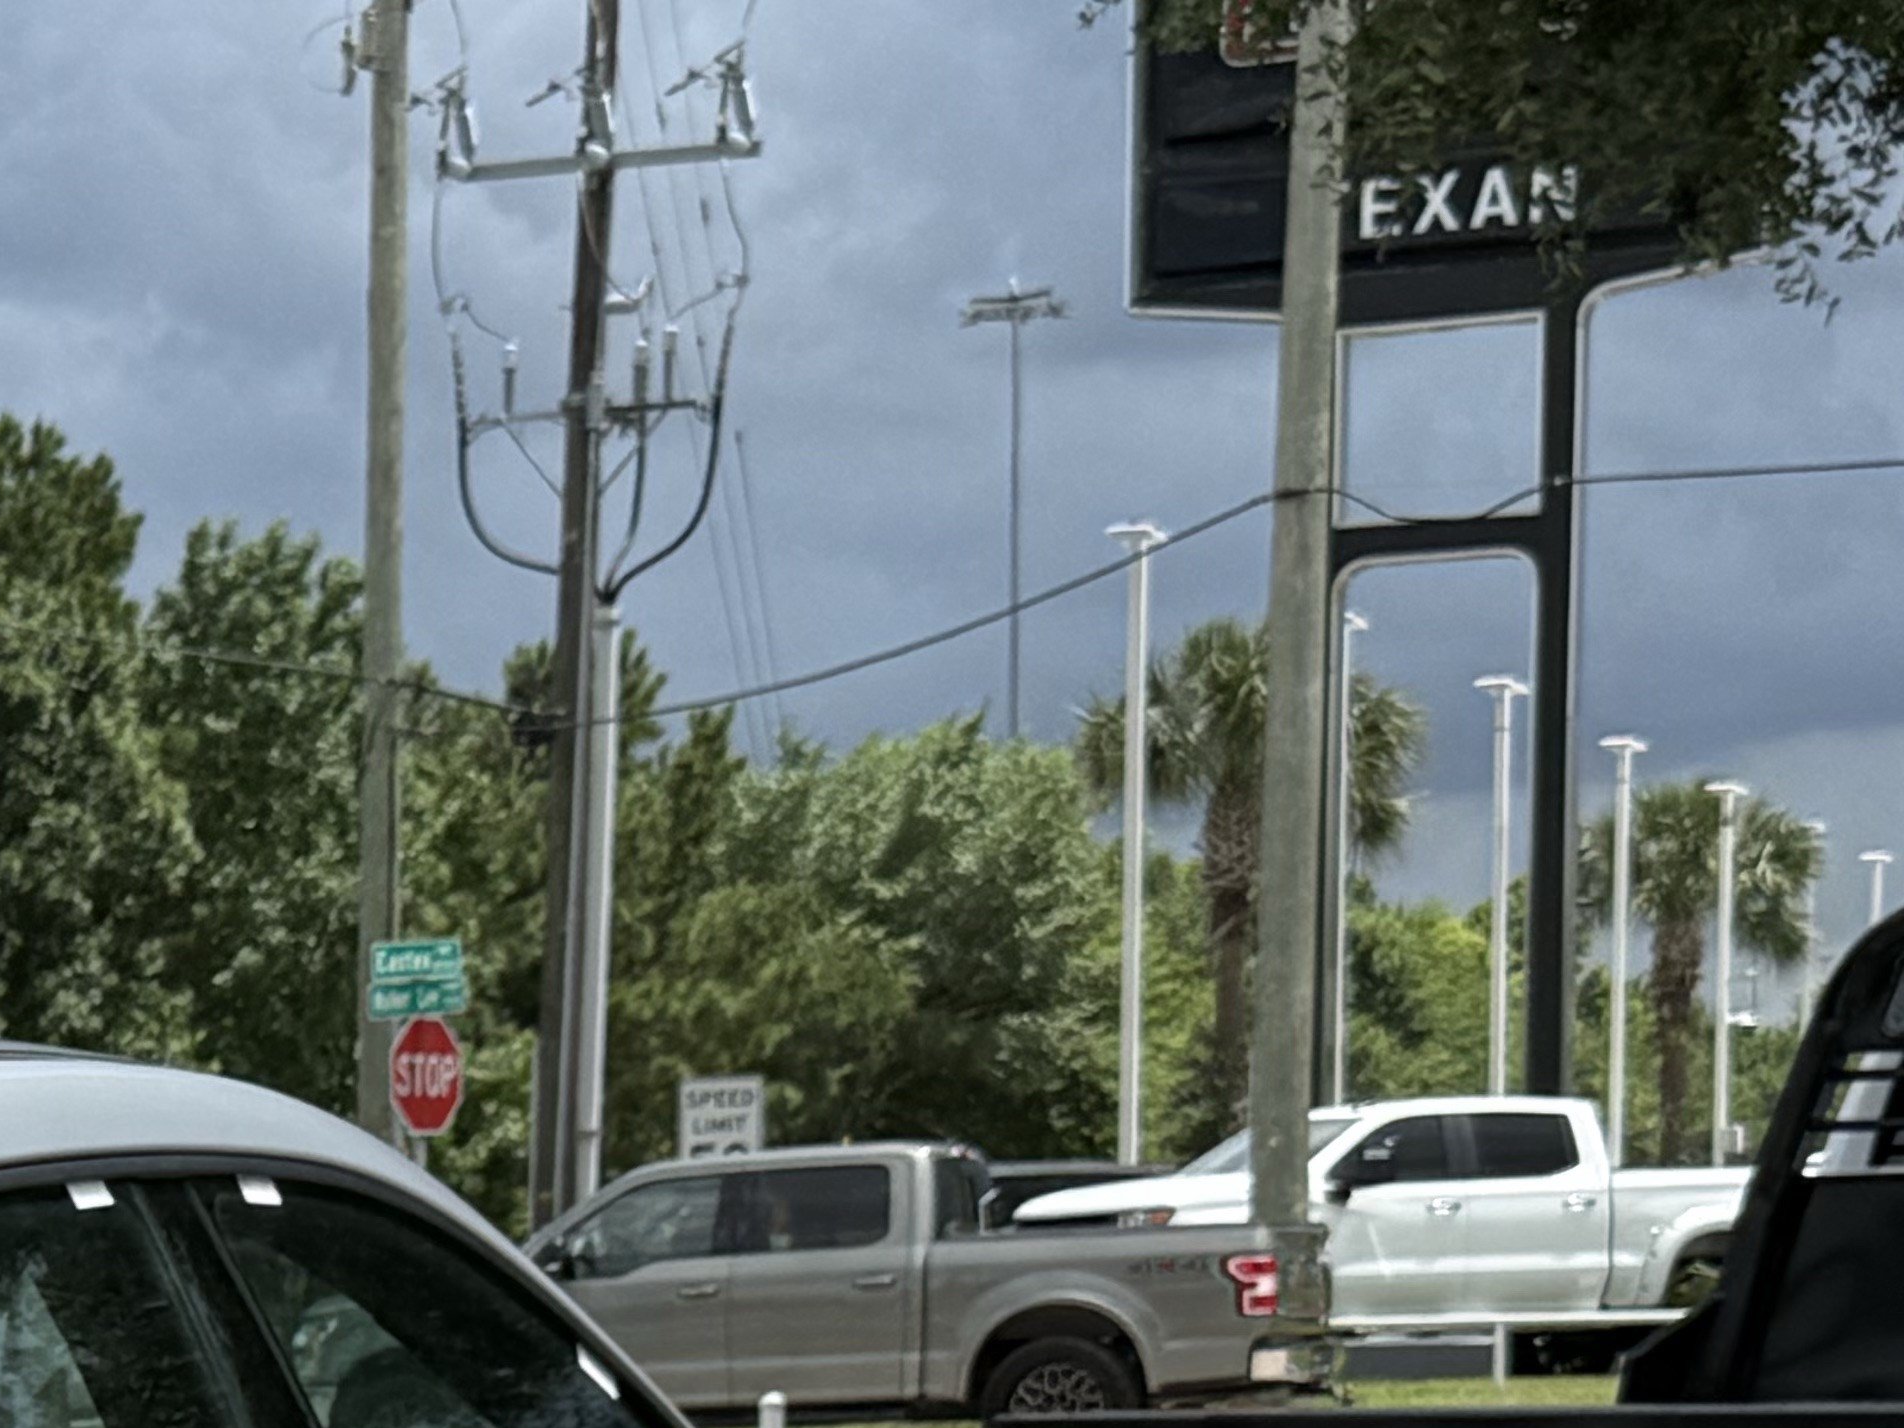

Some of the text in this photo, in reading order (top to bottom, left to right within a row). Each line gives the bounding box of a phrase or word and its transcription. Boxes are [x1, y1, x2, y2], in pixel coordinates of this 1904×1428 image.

[1340, 163, 1578, 240] EXAN
[394, 1053, 458, 1098] STOP
[687, 1087, 754, 1109] SPEED
[692, 1114, 749, 1135] LIMIT
